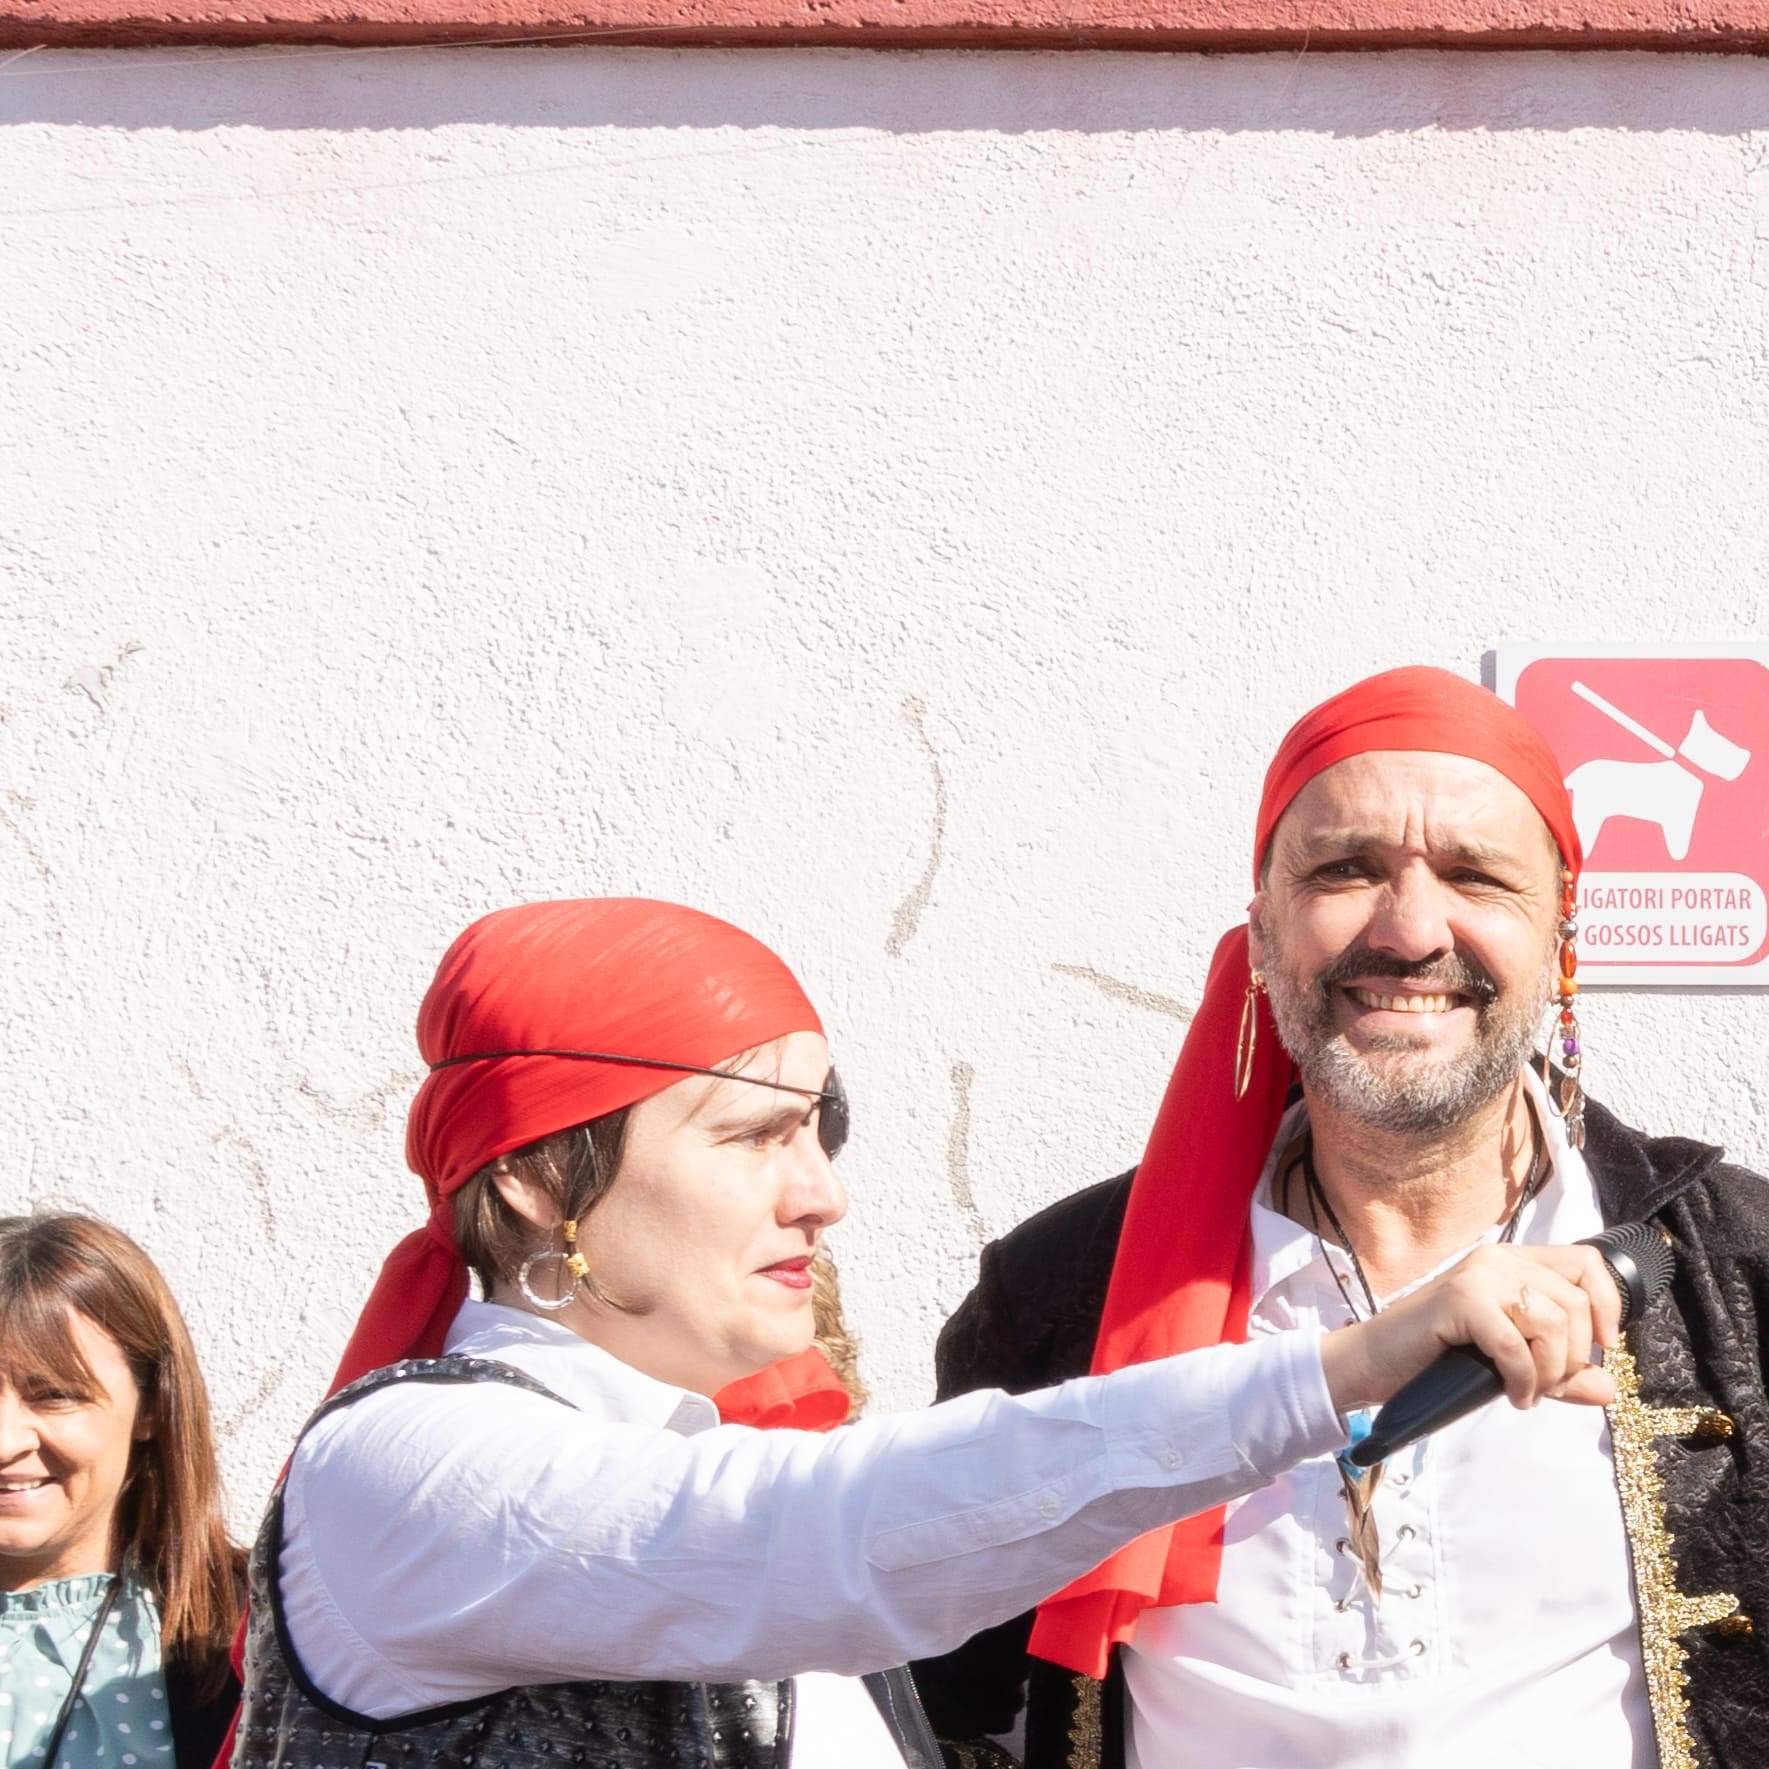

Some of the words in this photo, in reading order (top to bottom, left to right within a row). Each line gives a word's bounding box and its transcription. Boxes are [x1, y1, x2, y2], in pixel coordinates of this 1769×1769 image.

[1577, 888, 1663, 909] IGATORI
[1671, 888, 1751, 909] PORTAR
[1584, 925, 1663, 946] GOSSOS
[1670, 925, 1750, 946] LLIGATS
